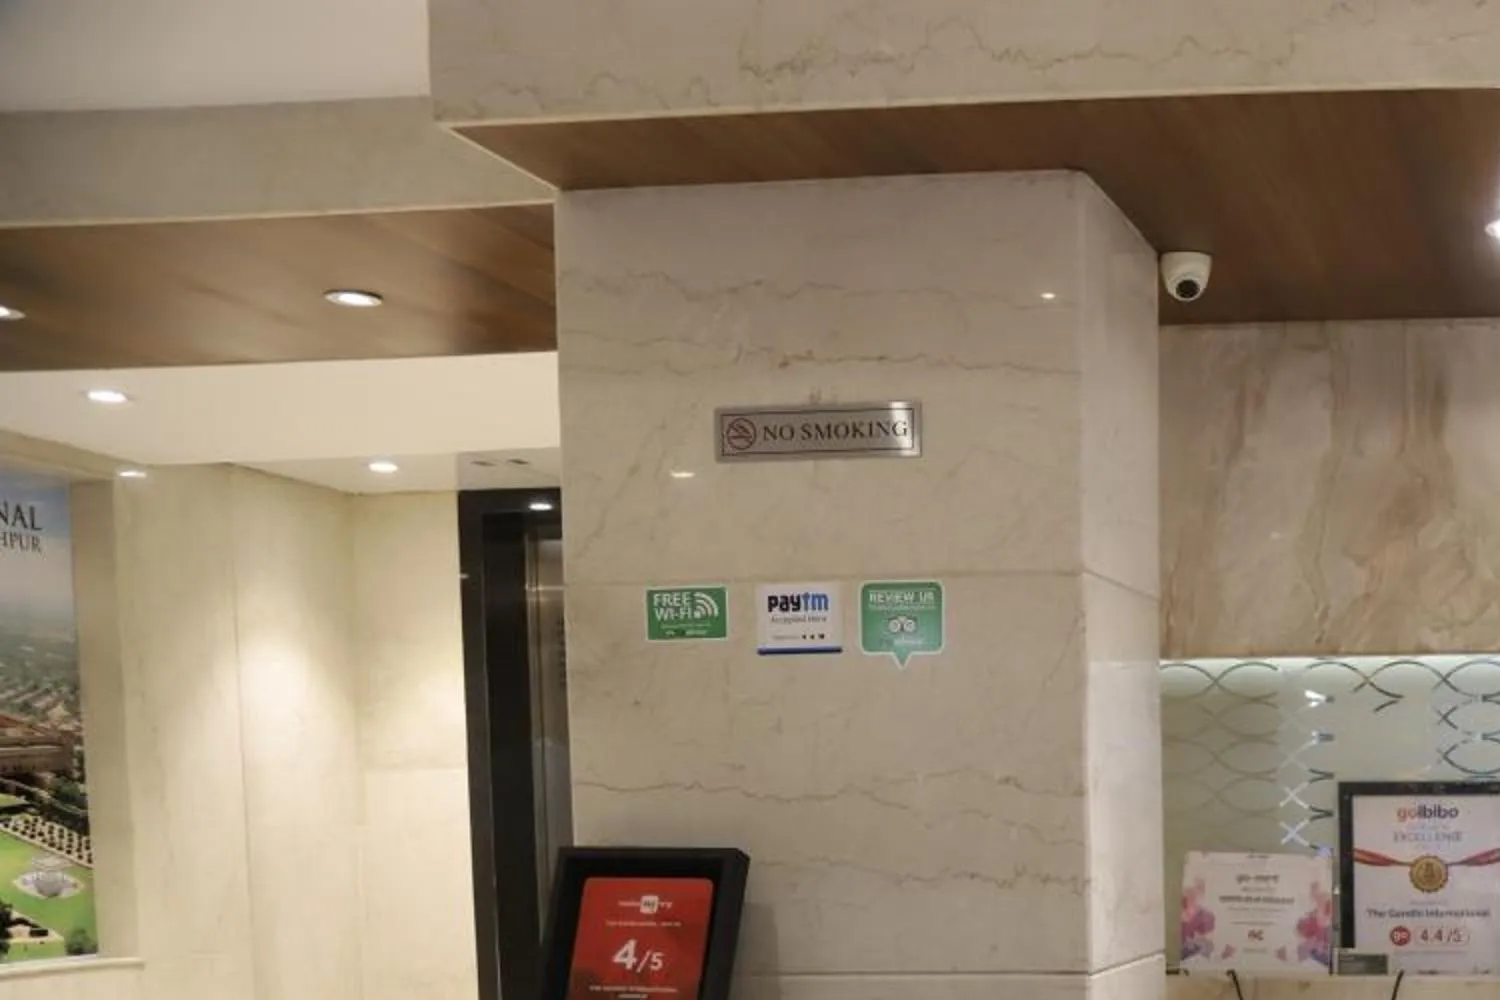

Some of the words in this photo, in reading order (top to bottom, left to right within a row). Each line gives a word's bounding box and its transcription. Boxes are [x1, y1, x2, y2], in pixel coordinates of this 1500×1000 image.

[763, 424, 795, 441] NO
[801, 420, 909, 441] SMOKING
[653, 591, 692, 607] FREE
[653, 606, 693, 621] WI-FI
[1396, 804, 1460, 821] goibibo
